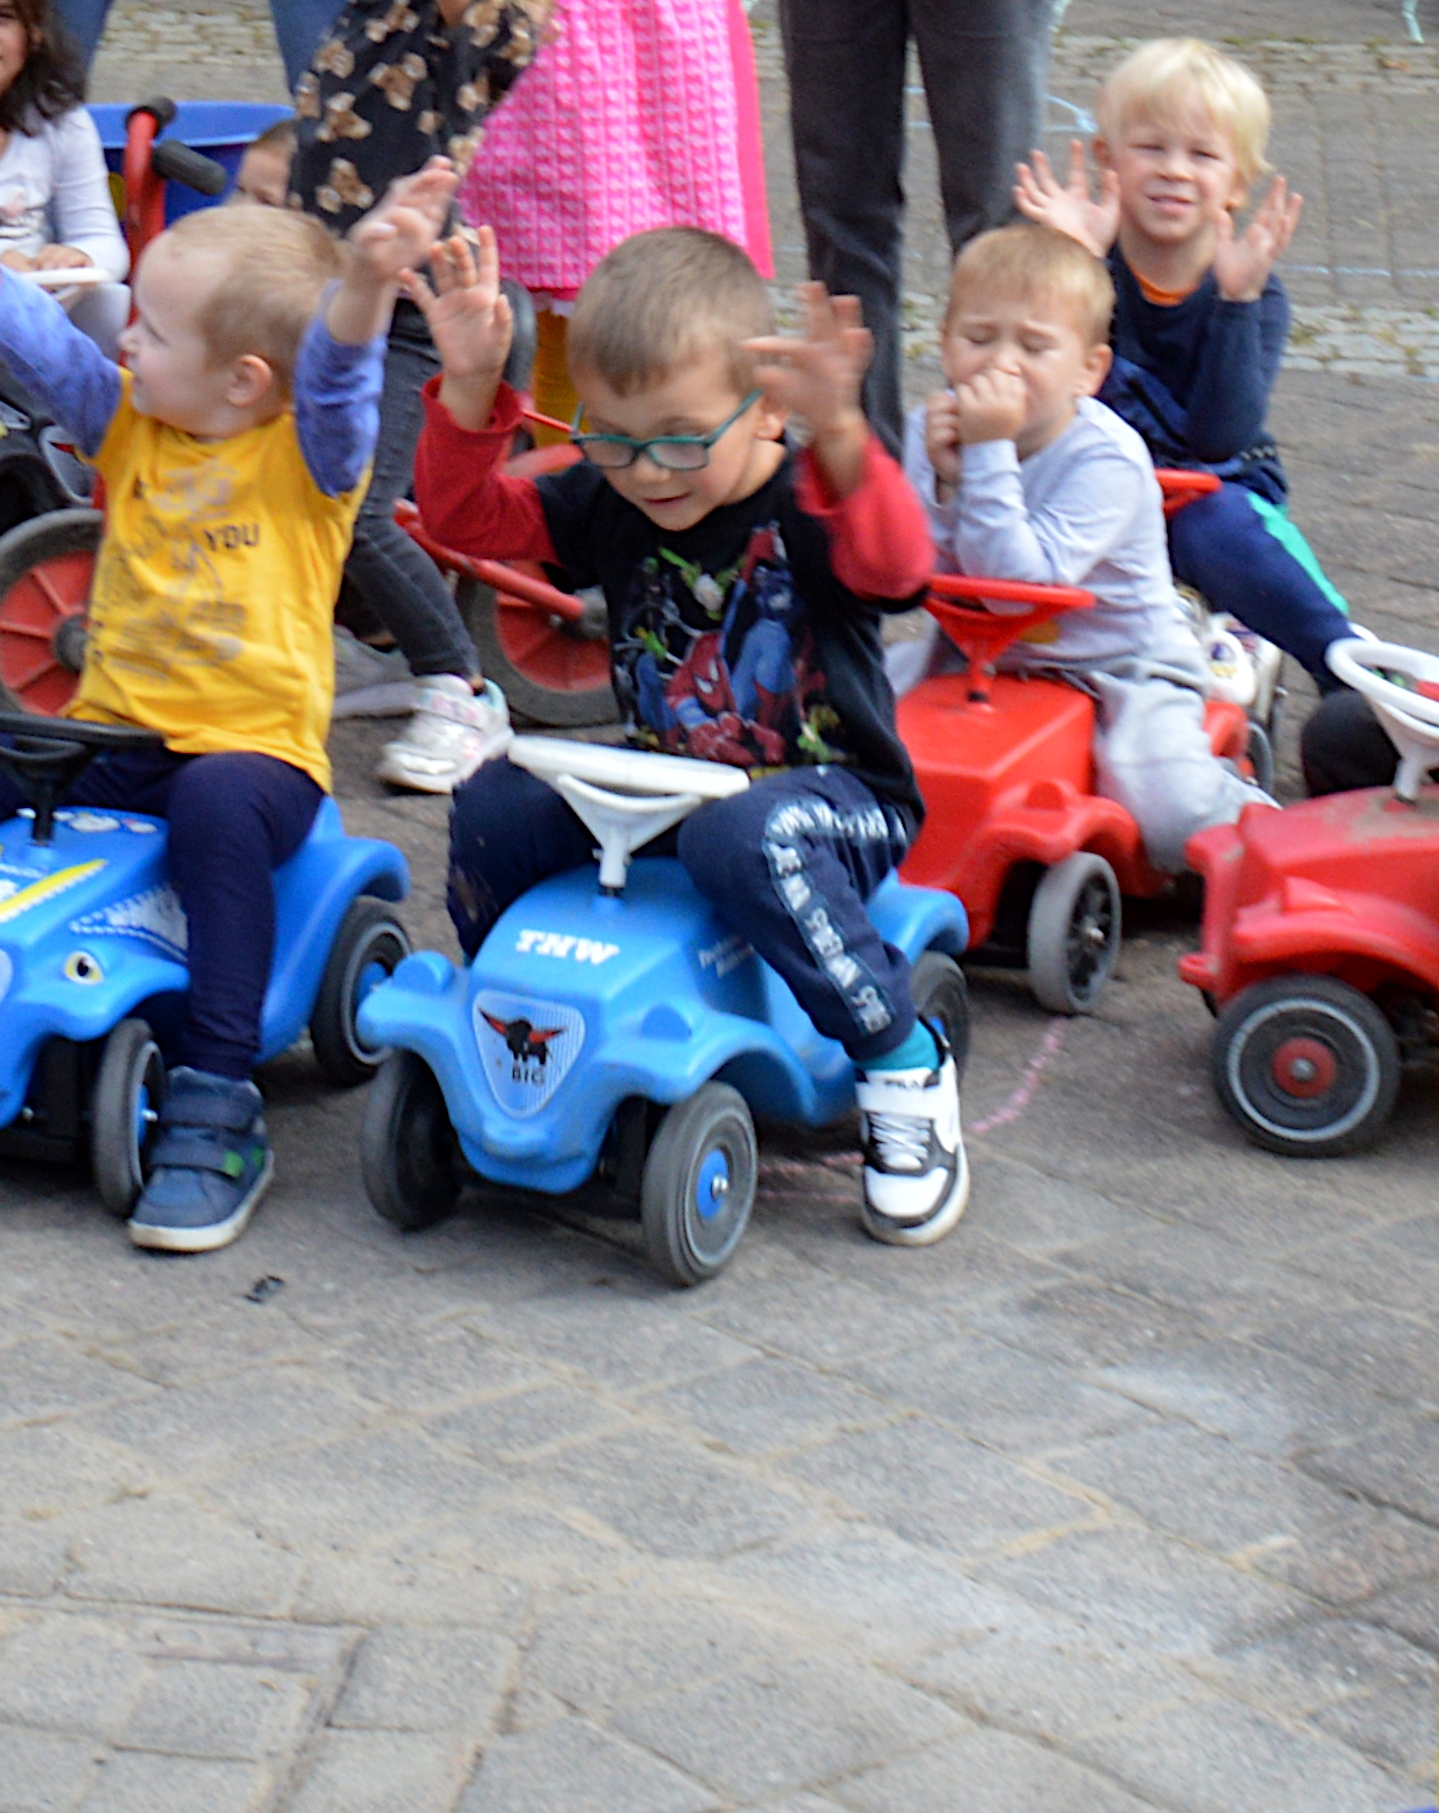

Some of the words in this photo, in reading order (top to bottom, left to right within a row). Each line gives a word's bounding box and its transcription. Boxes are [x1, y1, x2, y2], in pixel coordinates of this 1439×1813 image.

[203, 522, 260, 552] YOU
[515, 928, 621, 966] THW
[511, 1064, 546, 1086] BIG
